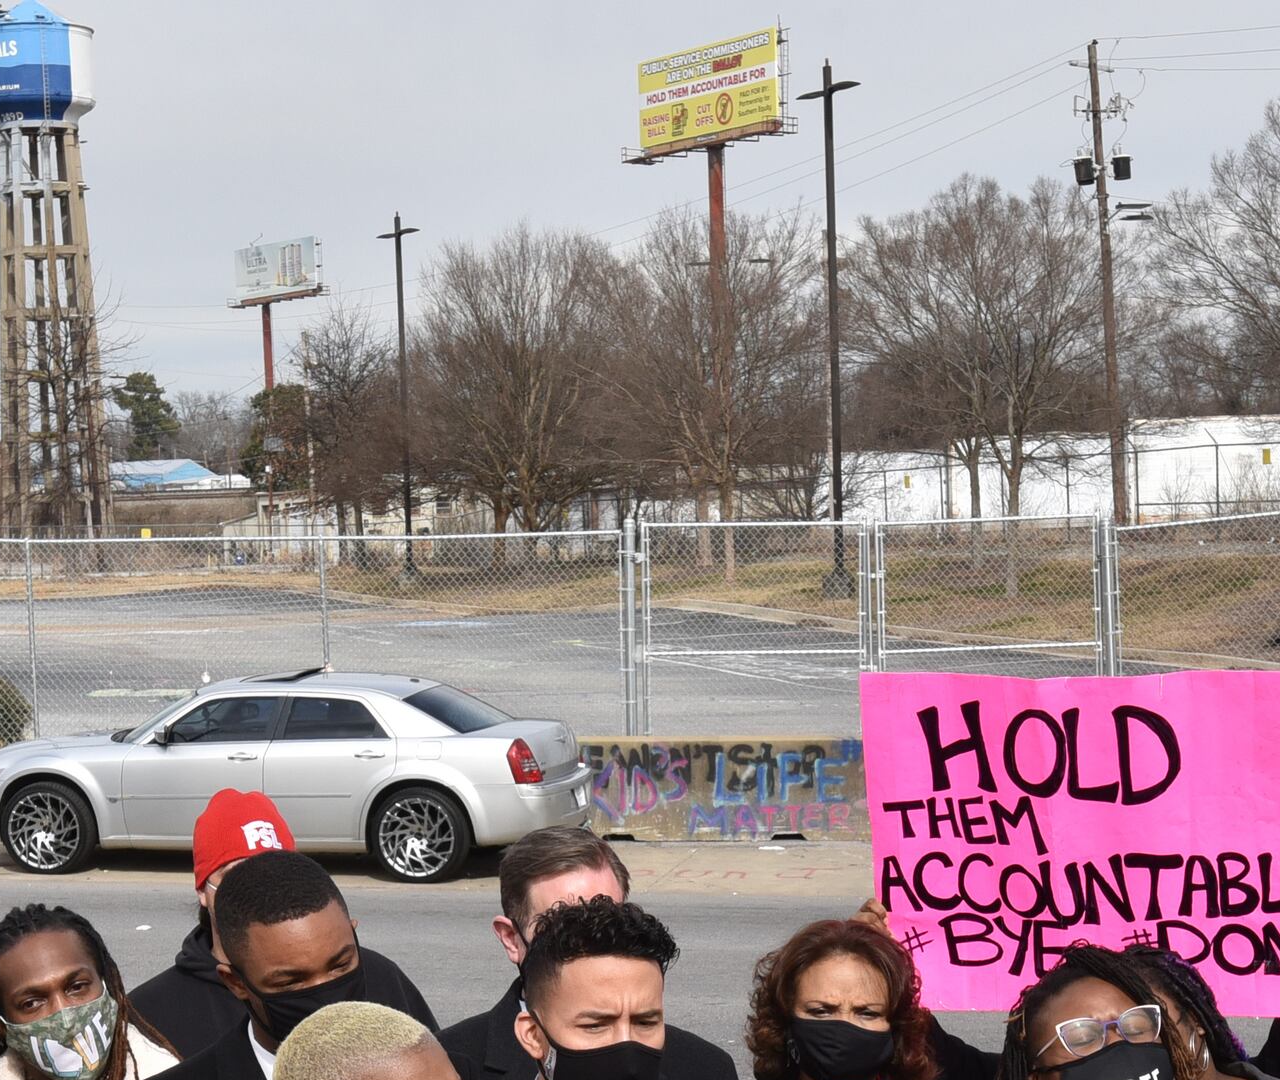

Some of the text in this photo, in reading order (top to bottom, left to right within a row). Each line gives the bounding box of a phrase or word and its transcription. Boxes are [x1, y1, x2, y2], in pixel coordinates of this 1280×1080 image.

[642, 32, 770, 76] PUBLIC SERVICE COMMISSIONERS
[646, 68, 766, 105] HOLD THEM ACCOUNTABLE FOR
[666, 70, 681, 84] ARE
[682, 68, 694, 80] ON
[696, 63, 712, 77] THE
[642, 112, 670, 126] RAISING
[695, 115, 714, 128] OFFS
[696, 104, 711, 115] CUT
[647, 126, 666, 138] BILLS
[916, 700, 1181, 805] HOLD
[714, 752, 850, 806] LIFE
[240, 820, 283, 850] PSL
[689, 804, 852, 838] MATTER
[883, 796, 1049, 855] THEM
